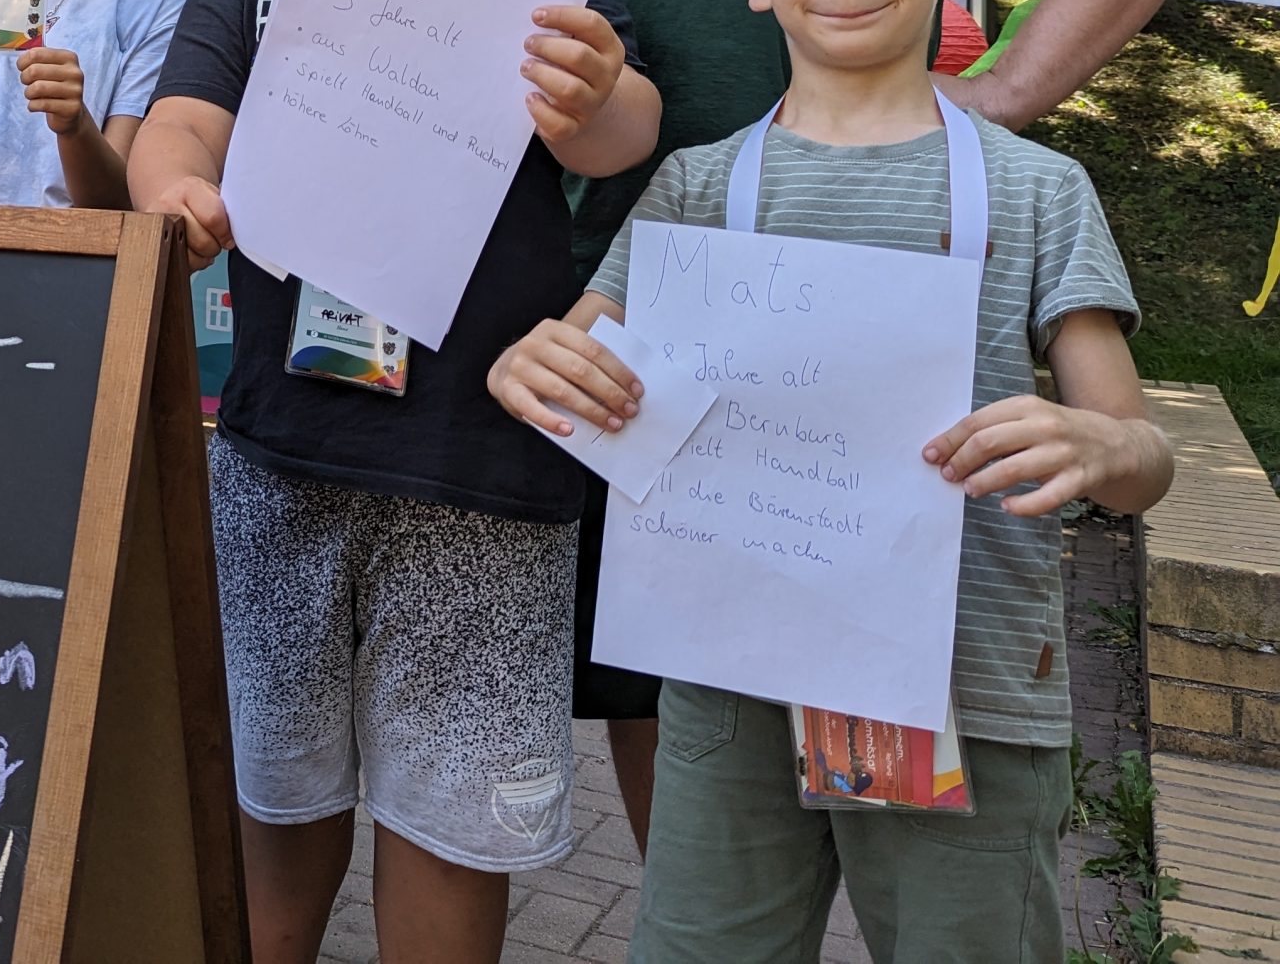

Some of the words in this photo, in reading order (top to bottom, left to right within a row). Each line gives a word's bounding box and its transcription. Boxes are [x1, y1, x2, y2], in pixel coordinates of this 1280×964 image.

[426, 23, 464, 49] alt
[312, 31, 346, 57] aus
[368, 44, 441, 102] Waldau
[282, 88, 329, 124] höhere
[361, 83, 424, 125] Handball
[432, 120, 460, 146] und
[649, 229, 815, 314] Mats
[694, 342, 764, 386] Jahre
[782, 356, 823, 388] alt
[725, 400, 848, 457] Bernburg
[755, 447, 860, 491] Handball
[688, 480, 726, 506] die
[749, 489, 865, 537] Bärenstadt
[629, 512, 720, 545] schöner
[742, 536, 834, 567] machen
